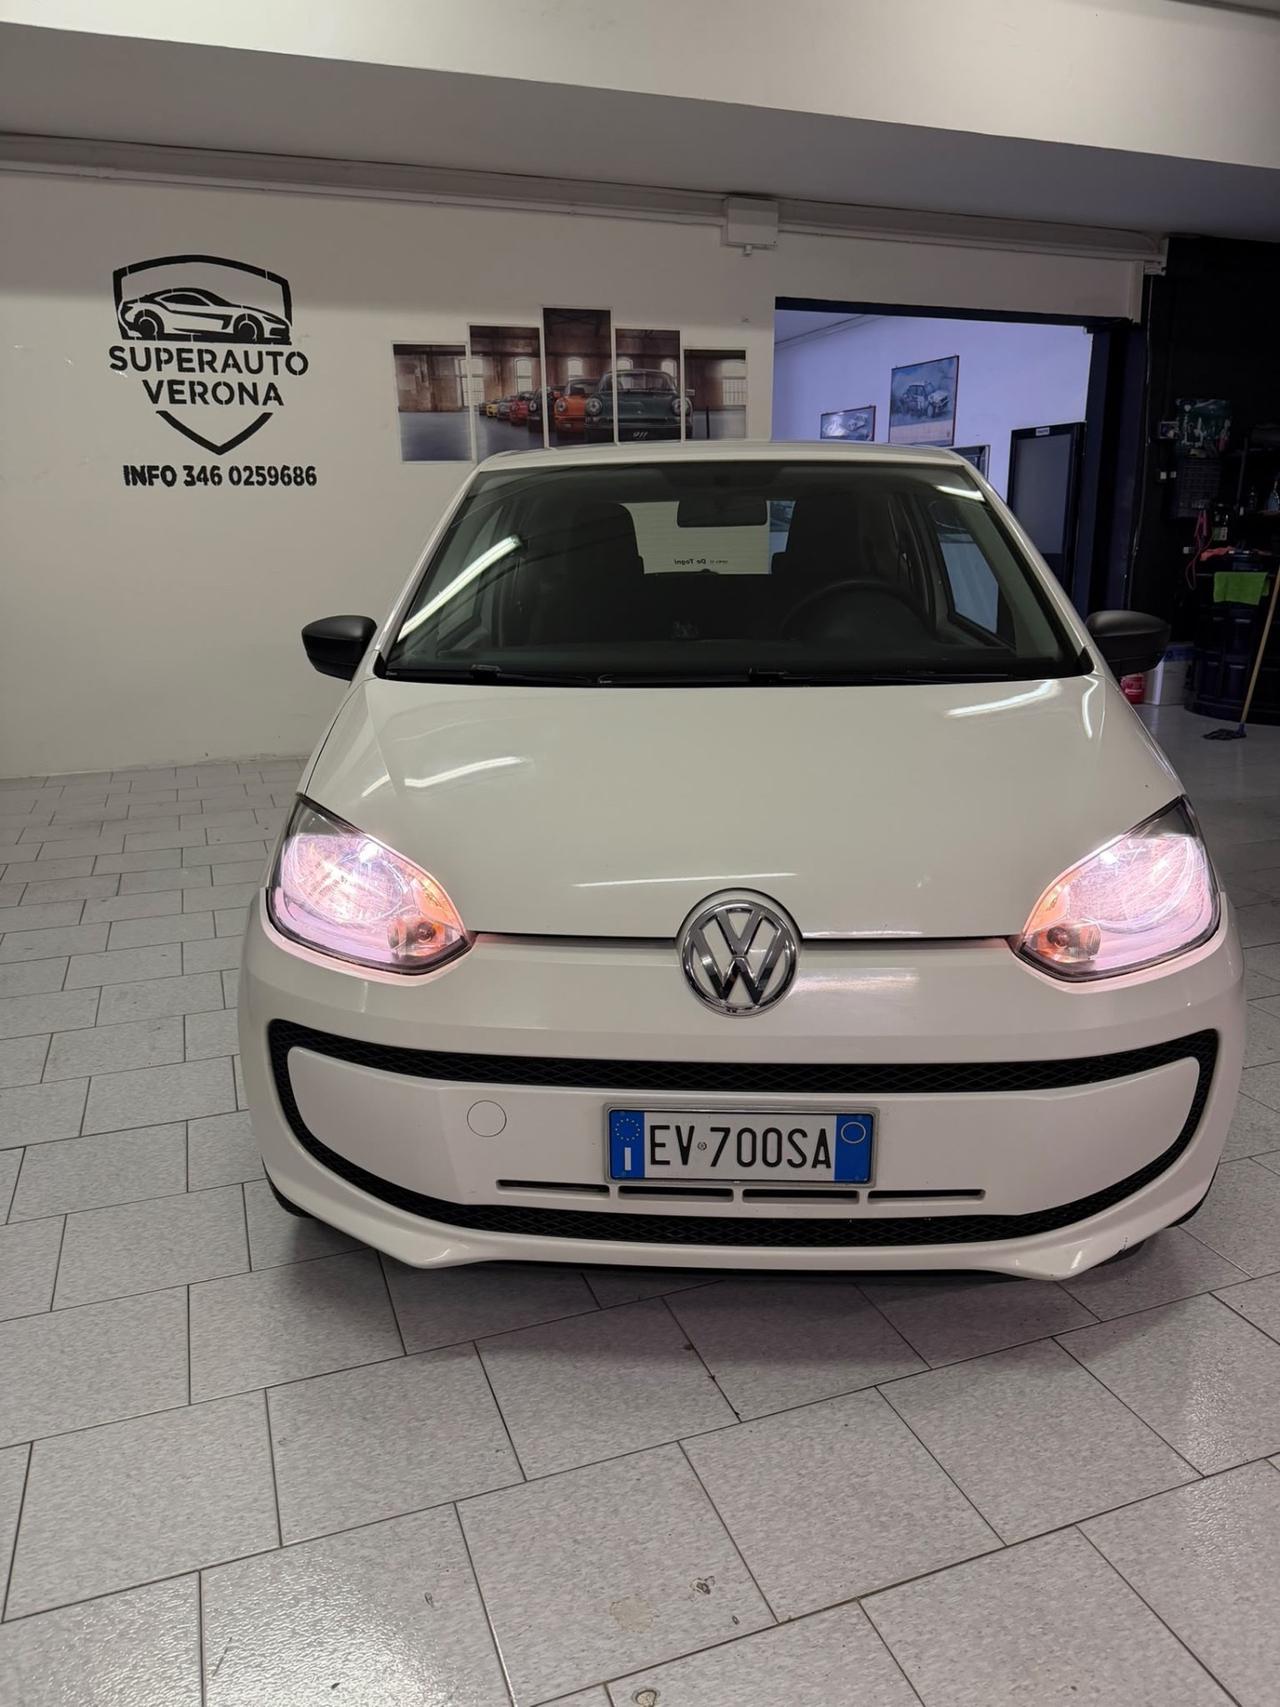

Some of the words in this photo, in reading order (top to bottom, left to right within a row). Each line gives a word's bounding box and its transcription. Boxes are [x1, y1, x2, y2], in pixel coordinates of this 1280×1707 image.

[108, 345, 309, 376] SUPERAUTO
[142, 379, 284, 406] VERONA
[122, 464, 177, 488] INFO
[183, 464, 223, 487] 346
[228, 464, 317, 487] 0259686
